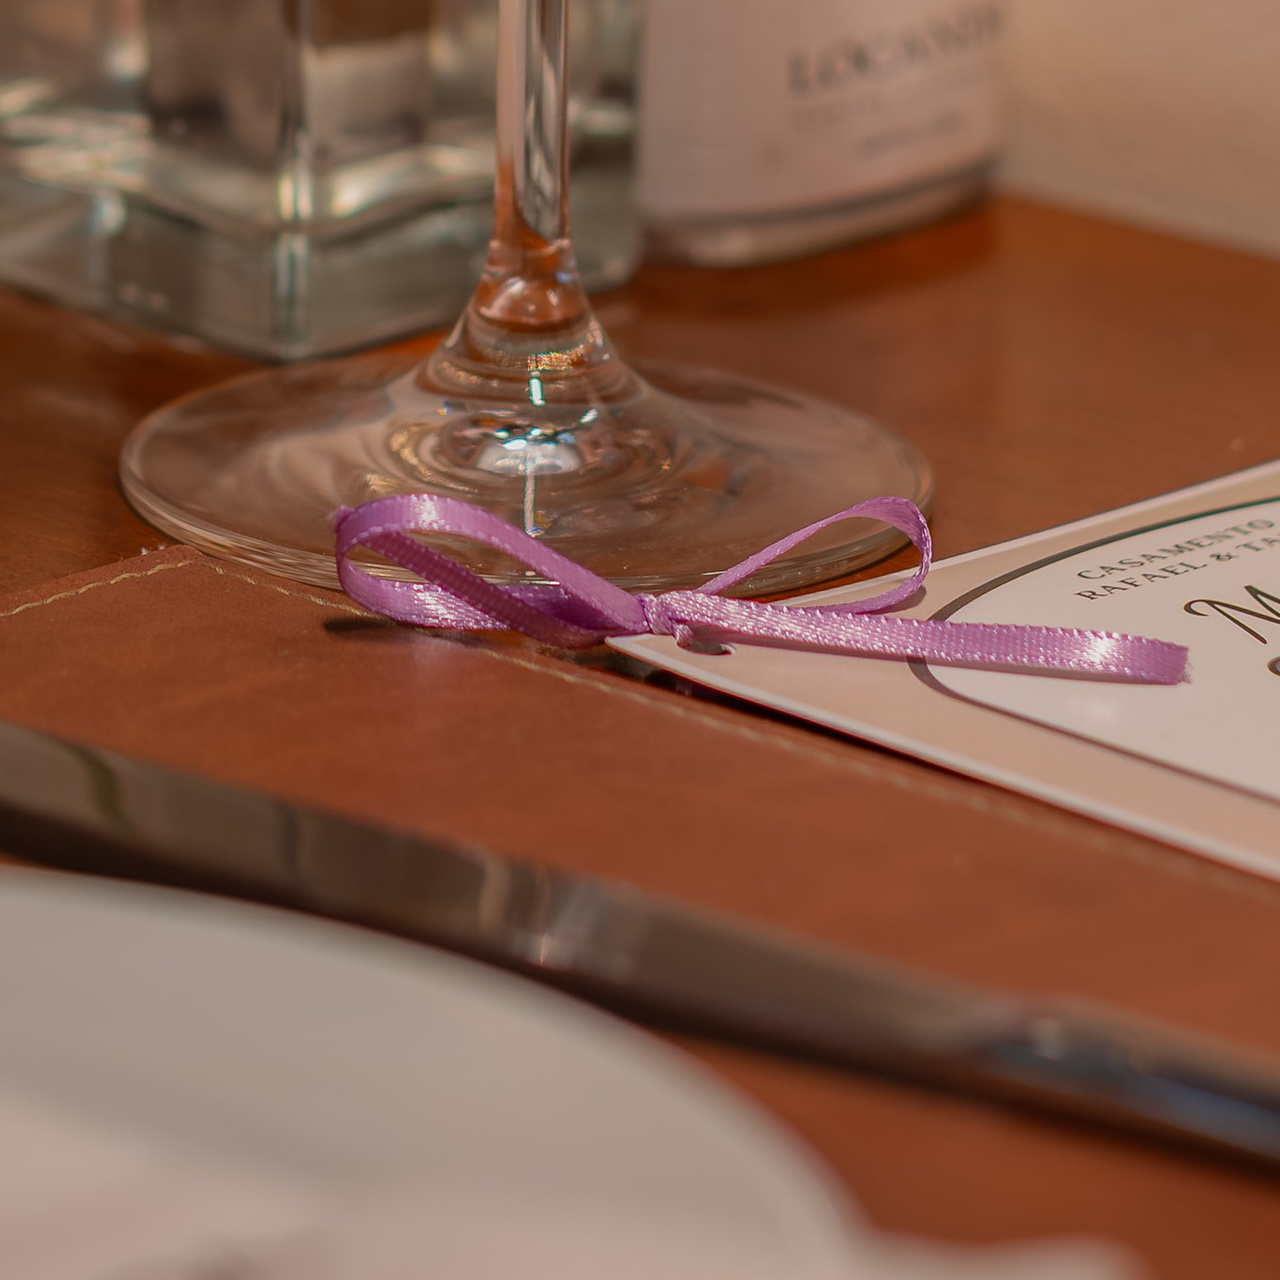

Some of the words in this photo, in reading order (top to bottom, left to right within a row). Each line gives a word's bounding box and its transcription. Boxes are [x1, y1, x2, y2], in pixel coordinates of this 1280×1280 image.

[1073, 561, 1208, 601] RAFAEL
[1209, 551, 1238, 562] &
[1076, 518, 1275, 580] CASAMENTO
